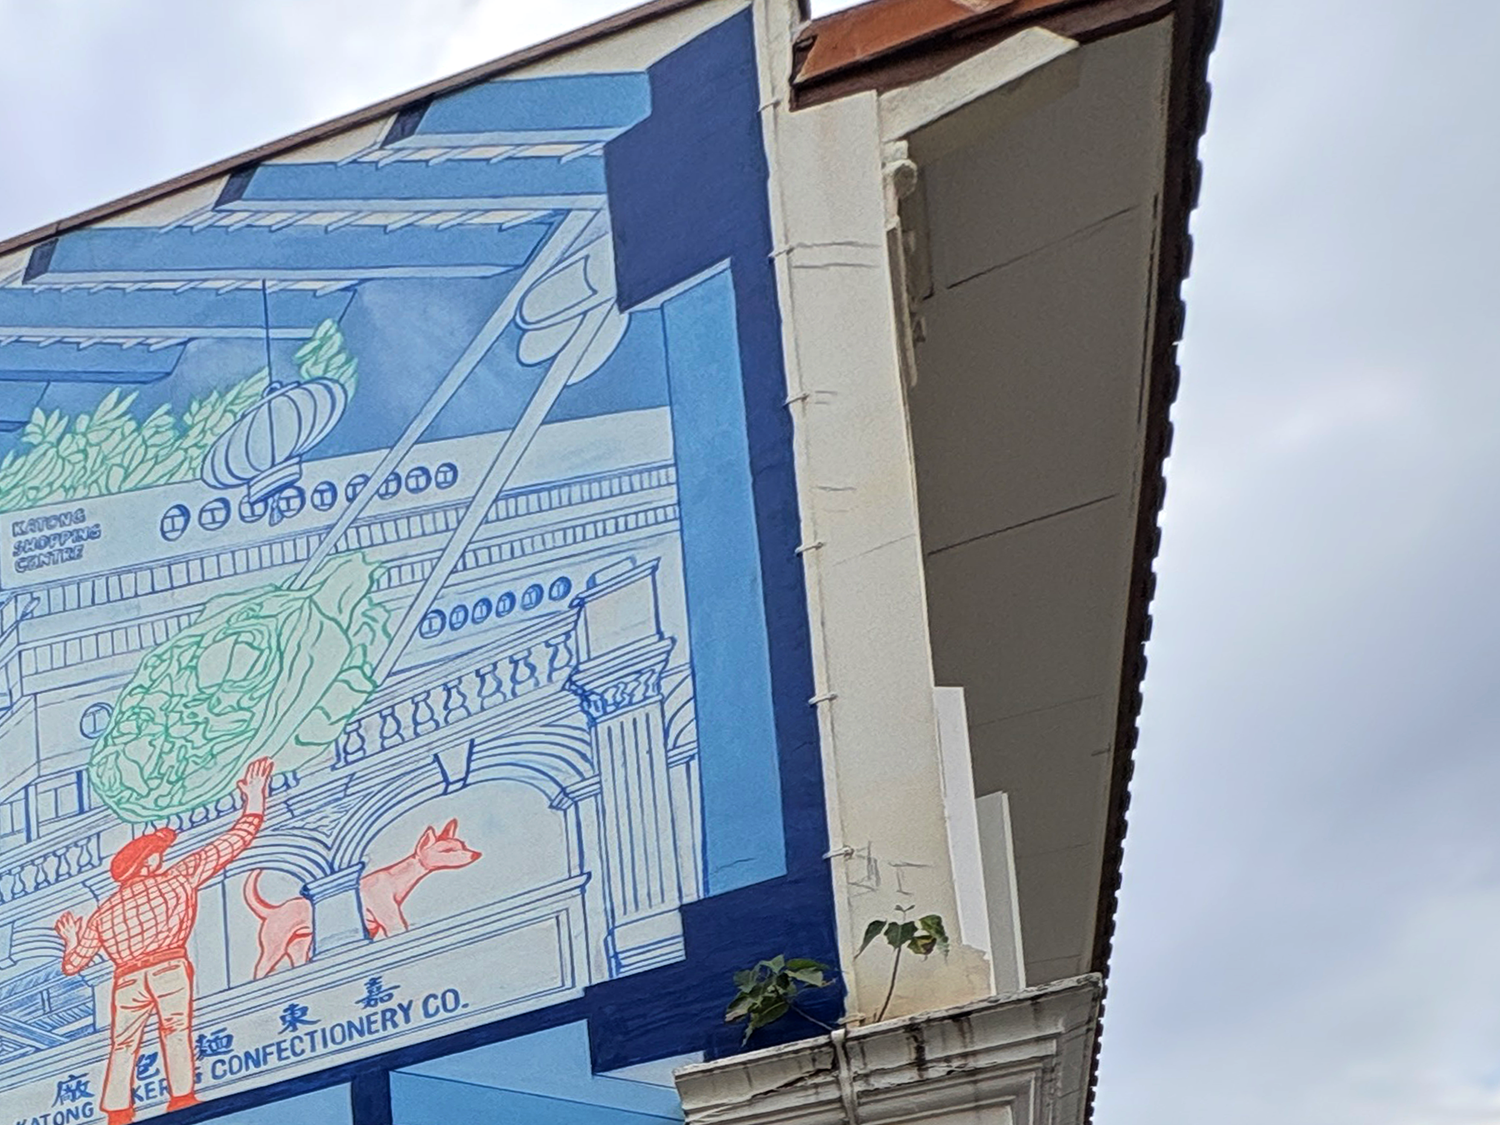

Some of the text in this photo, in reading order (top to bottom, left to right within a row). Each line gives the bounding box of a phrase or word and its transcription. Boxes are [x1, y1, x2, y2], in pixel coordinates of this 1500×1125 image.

[12, 508, 86, 537] KATONG
[12, 523, 102, 557] SHOPPING
[14, 544, 84, 573] CENTRE
[210, 999, 415, 1080] CONFECTIONERY
[422, 988, 470, 1019] CO.
